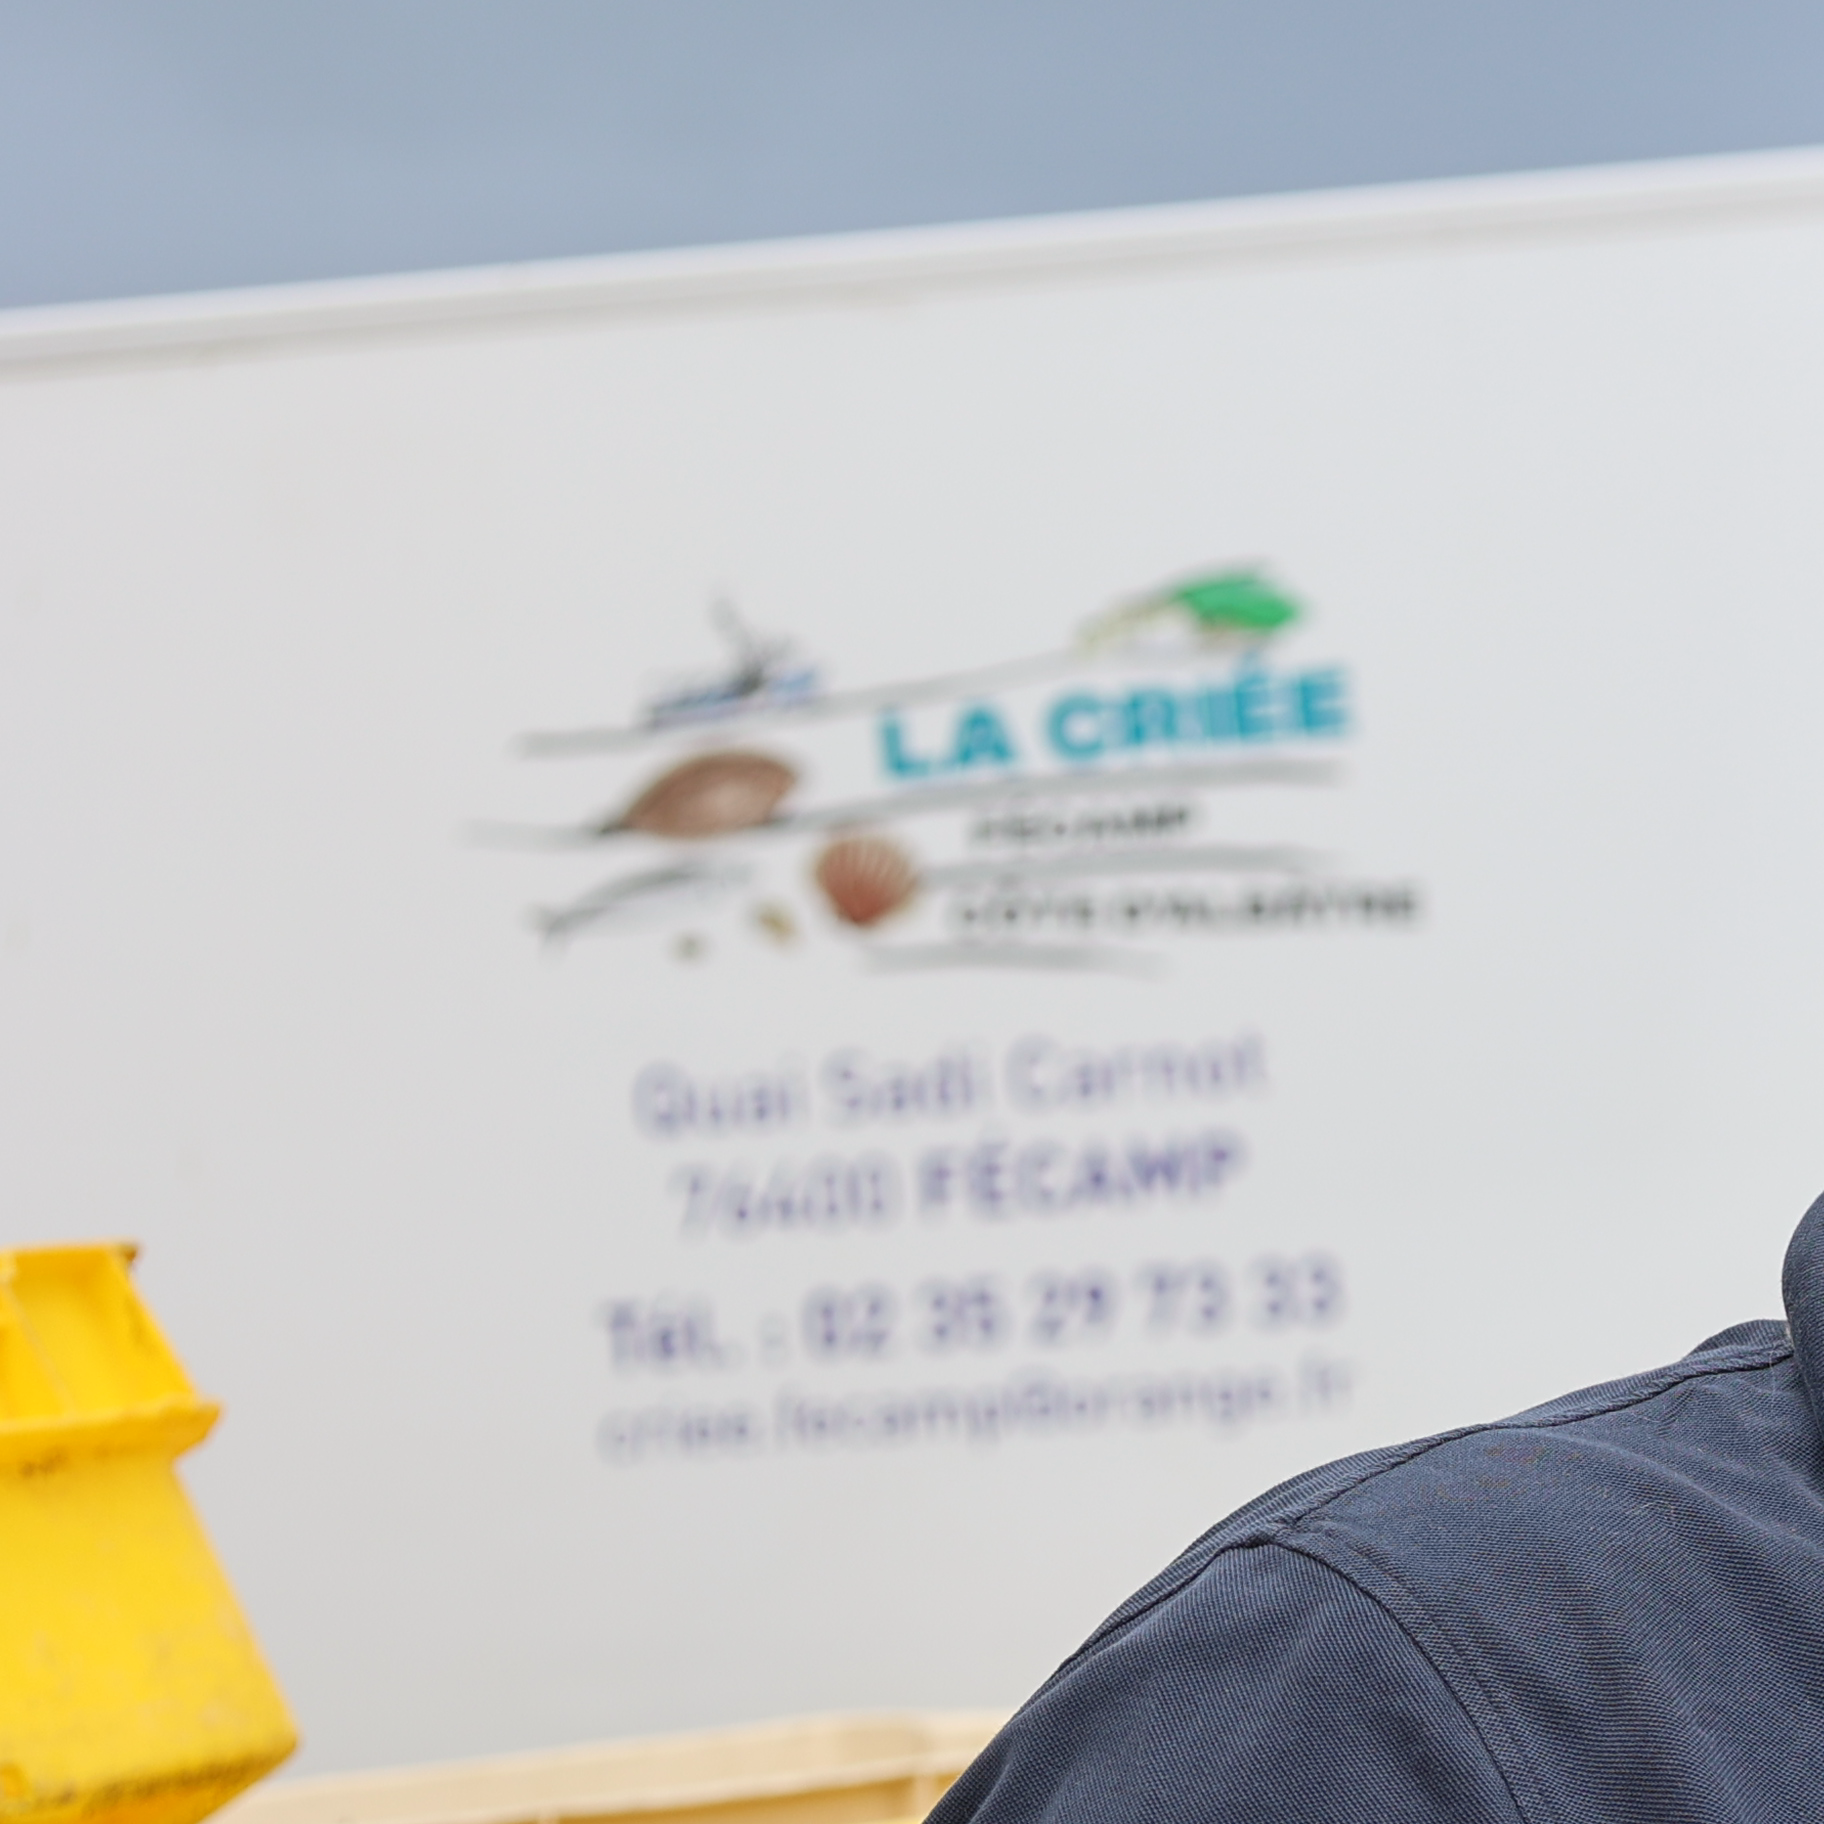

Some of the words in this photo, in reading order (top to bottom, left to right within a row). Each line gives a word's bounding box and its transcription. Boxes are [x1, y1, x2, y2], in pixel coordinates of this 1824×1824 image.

[877, 704, 1017, 778] LA
[1046, 653, 1352, 761] CRIÉE
[633, 1056, 804, 1139] Quai
[822, 1044, 986, 1127] Sadi
[1007, 1033, 1264, 1112] Carnot
[916, 1130, 1245, 1221] FÉCAMP
[803, 1282, 896, 1362] 02
[1025, 1264, 1121, 1348] 29
[1136, 1257, 1232, 1338] 73
[1247, 1249, 1345, 1328] 33
